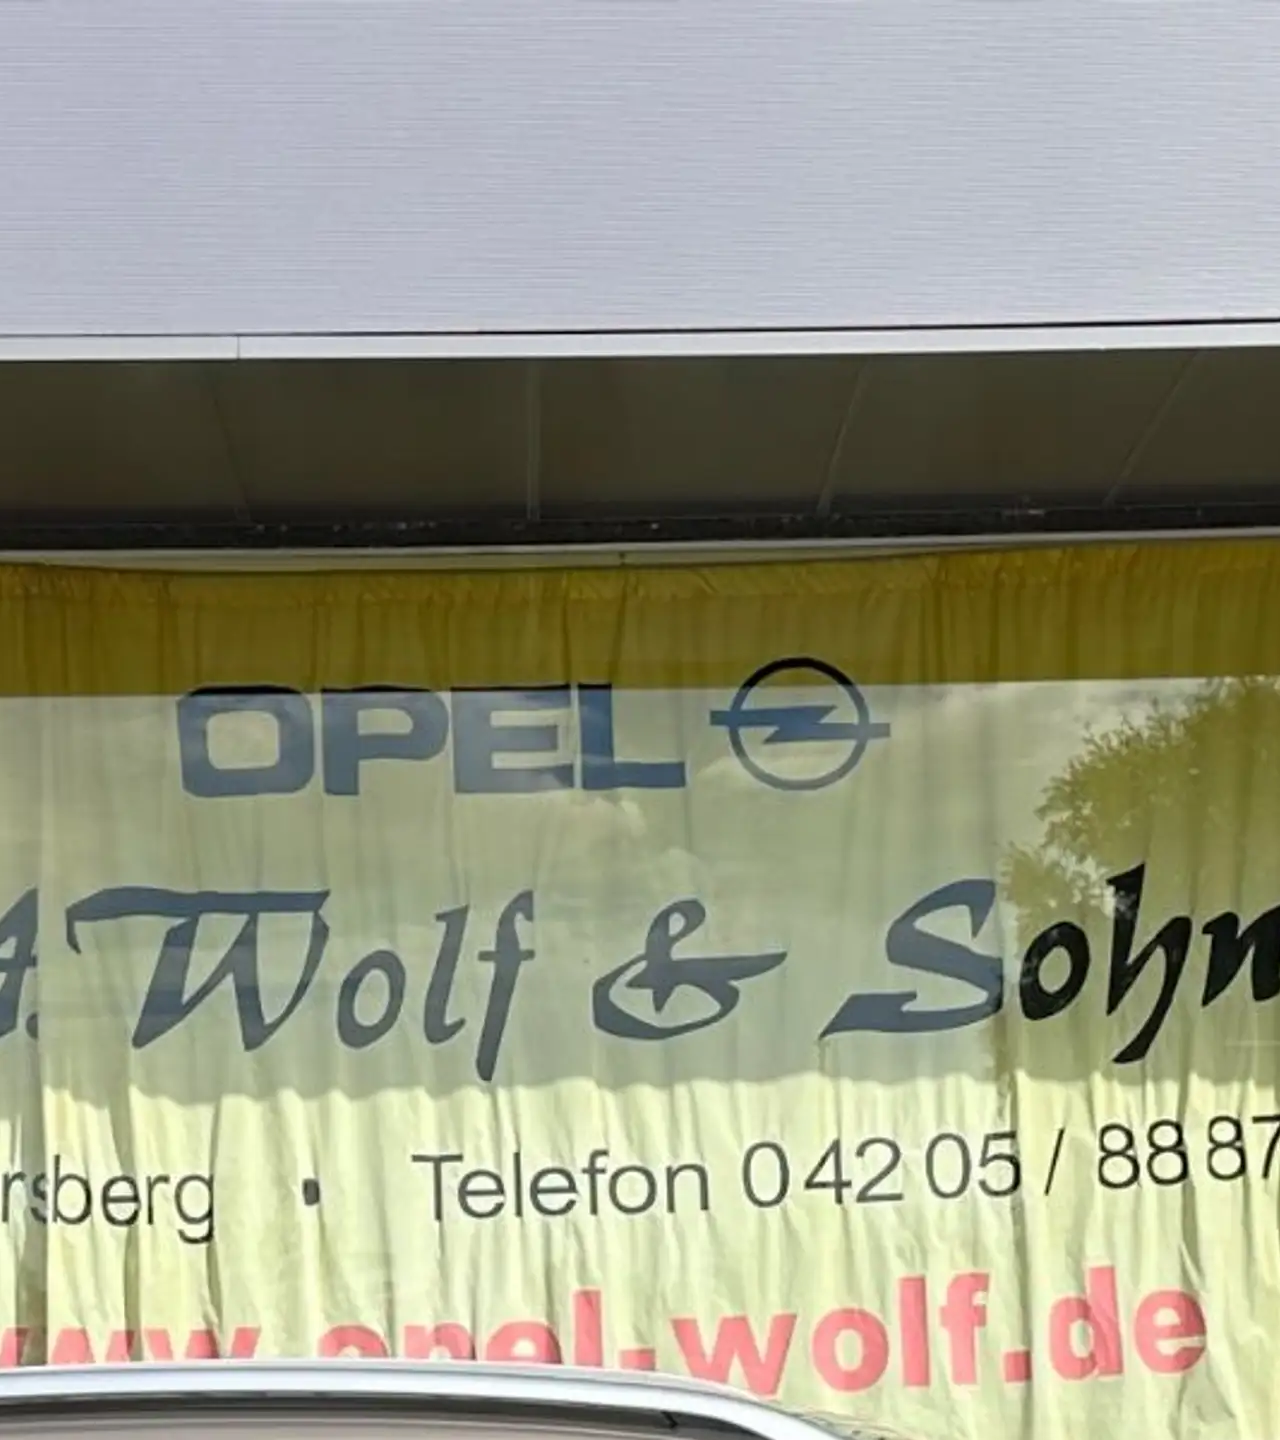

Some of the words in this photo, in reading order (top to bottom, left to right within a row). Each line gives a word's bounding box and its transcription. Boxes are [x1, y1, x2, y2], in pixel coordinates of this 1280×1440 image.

[177, 682, 686, 798] OPEL
[65, 886, 536, 1083] Wolf
[592, 897, 788, 1041] &
[411, 1148, 710, 1222] Telefon
